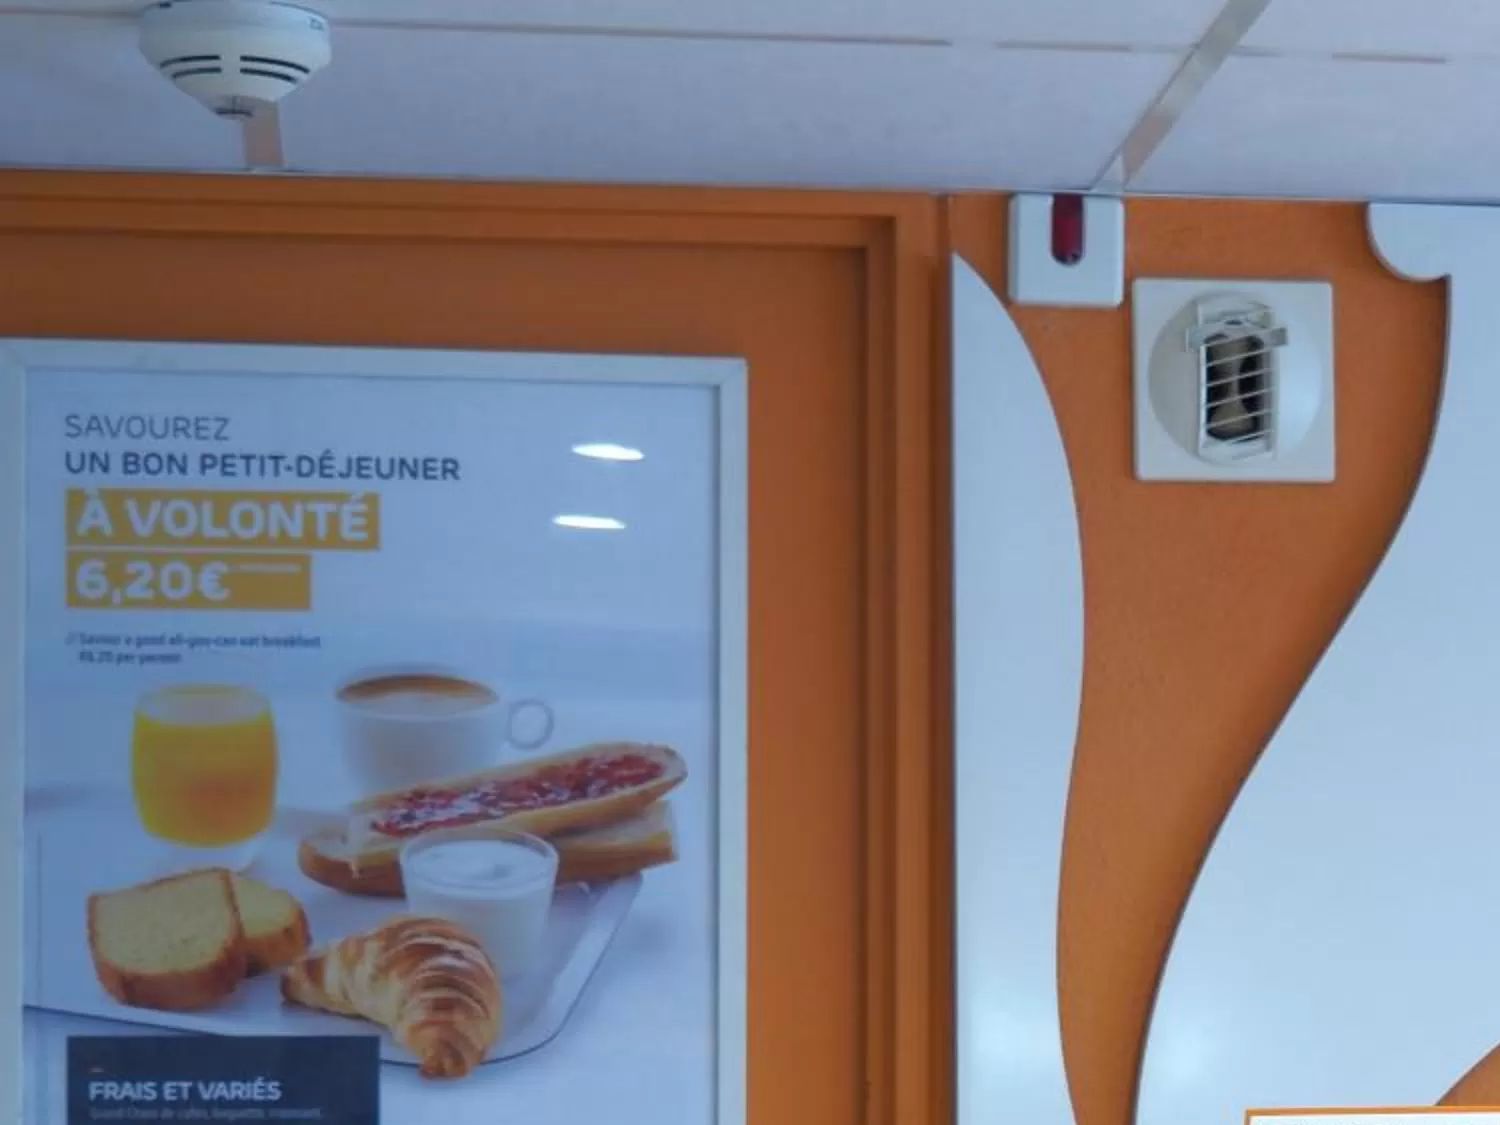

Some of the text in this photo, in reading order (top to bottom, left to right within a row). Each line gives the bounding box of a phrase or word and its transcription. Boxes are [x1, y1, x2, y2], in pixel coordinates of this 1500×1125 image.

[64, 414, 230, 441] SAVOUREZ
[65, 450, 461, 481] UN BON PETIT-DÉJEUNER
[77, 488, 369, 541] À VOLONTÉ
[75, 560, 231, 604] 6,20€
[88, 1077, 282, 1101] FRAIS ET VARIÉS
